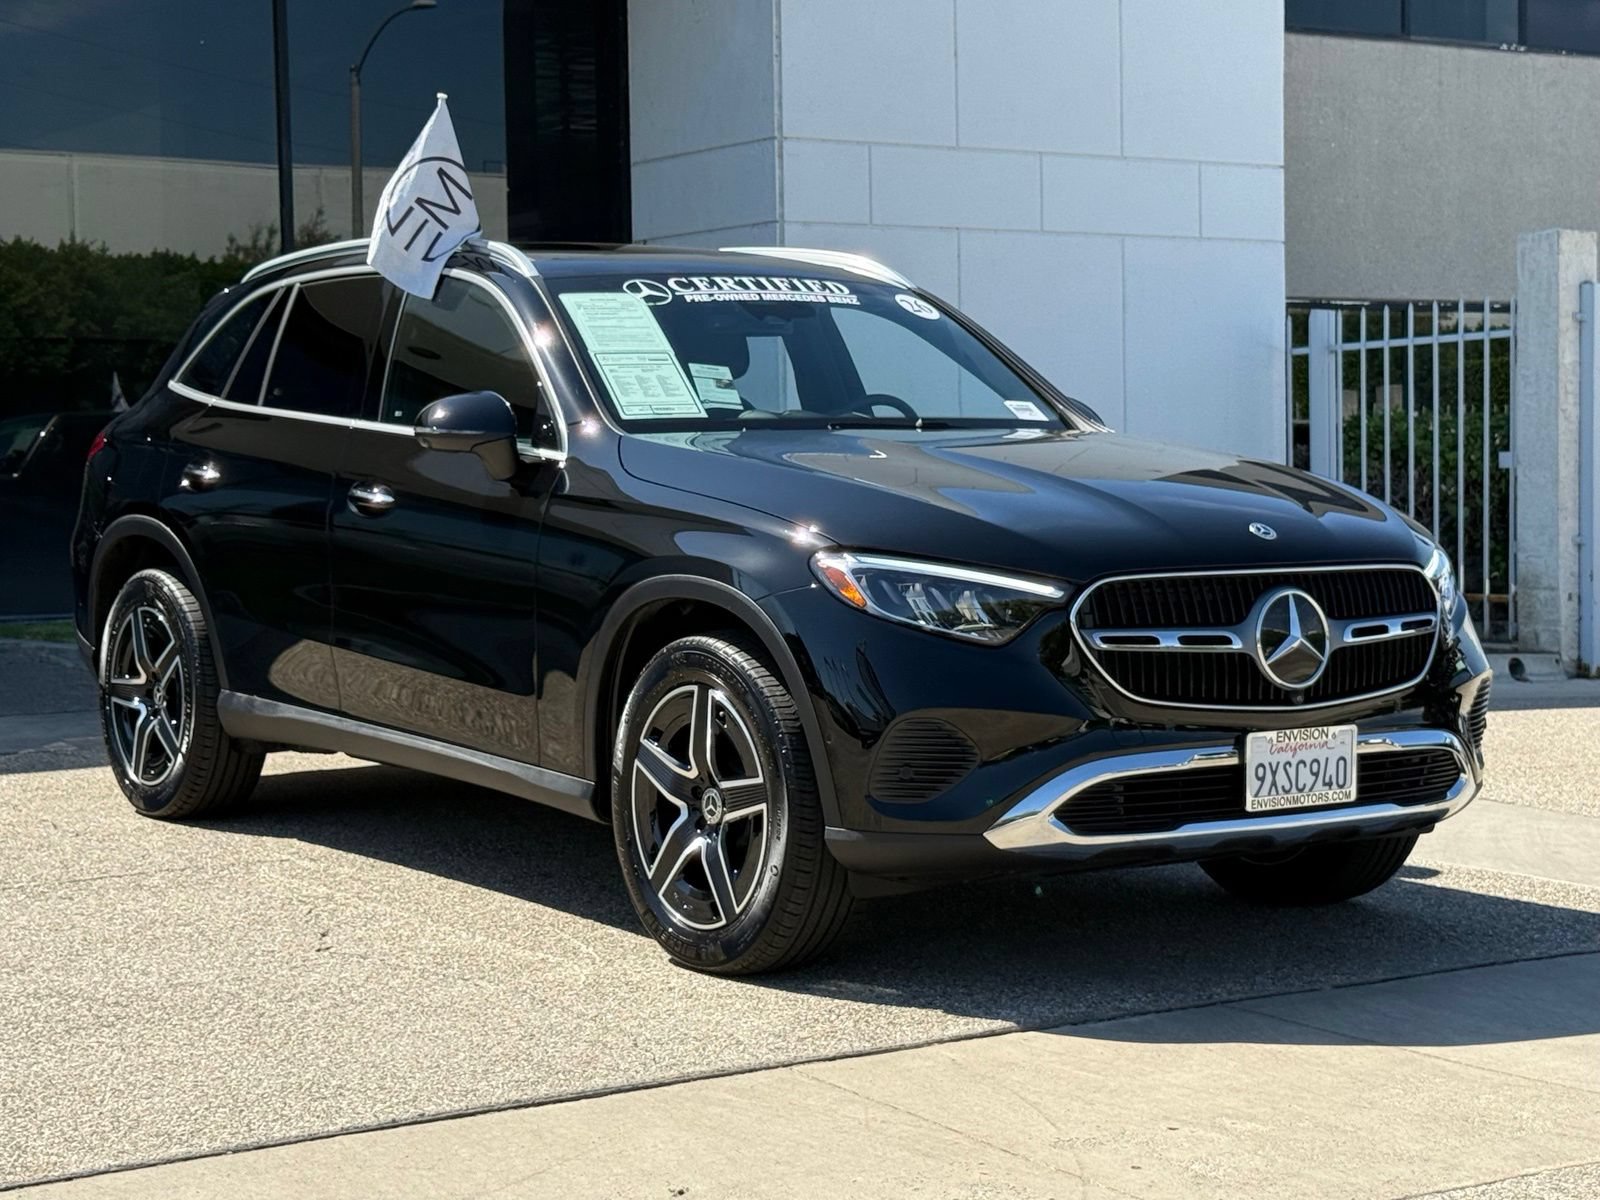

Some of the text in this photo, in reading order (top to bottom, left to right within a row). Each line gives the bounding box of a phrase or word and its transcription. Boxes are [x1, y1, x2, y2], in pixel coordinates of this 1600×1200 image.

[667, 276, 850, 295] CERTIFIED
[683, 293, 860, 306] PRE-OWNED MERCEDES BENZ
[1276, 728, 1329, 743] ENVISION
[1269, 741, 1336, 758] California
[1254, 756, 1347, 798] 9XSC940
[1251, 790, 1352, 810] ENVISIONMOTORS.COM
